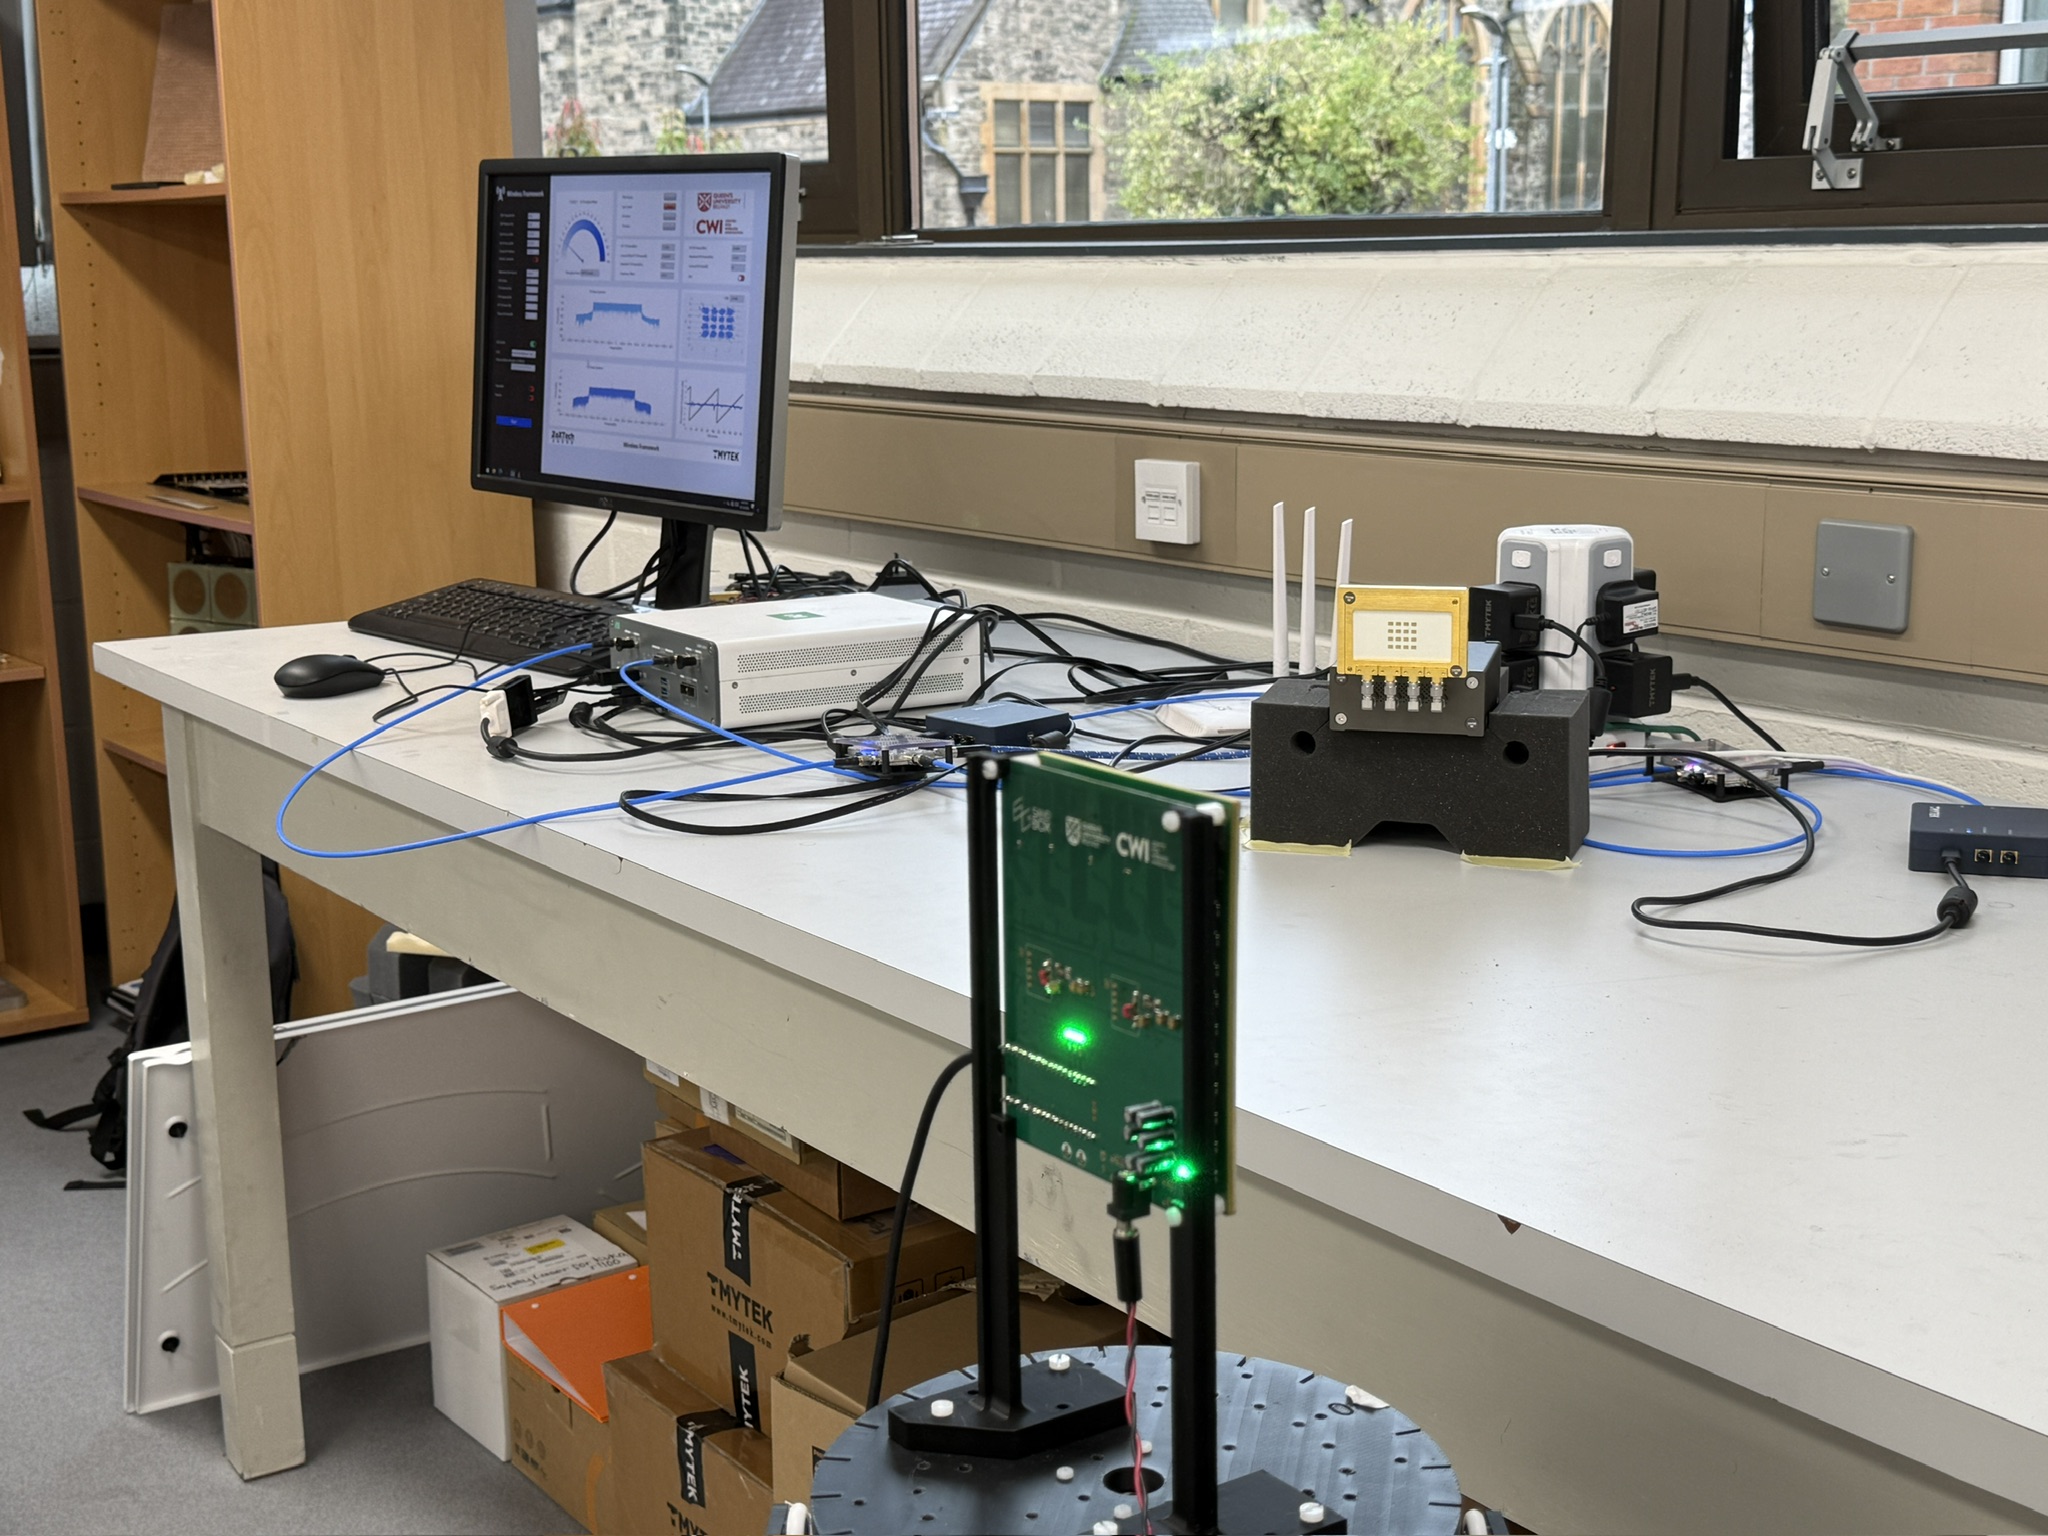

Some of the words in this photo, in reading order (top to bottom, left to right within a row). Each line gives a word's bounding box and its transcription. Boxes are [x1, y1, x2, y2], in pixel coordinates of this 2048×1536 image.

[696, 219, 723, 234] CWI
[713, 449, 739, 462] TMYTEK
[1484, 599, 1492, 638] TMYTEK
[1648, 668, 1656, 708] TMYTEK
[1116, 832, 1150, 864] CWI
[707, 1271, 773, 1334] TMYTEK
[738, 1364, 754, 1428] YTEK
